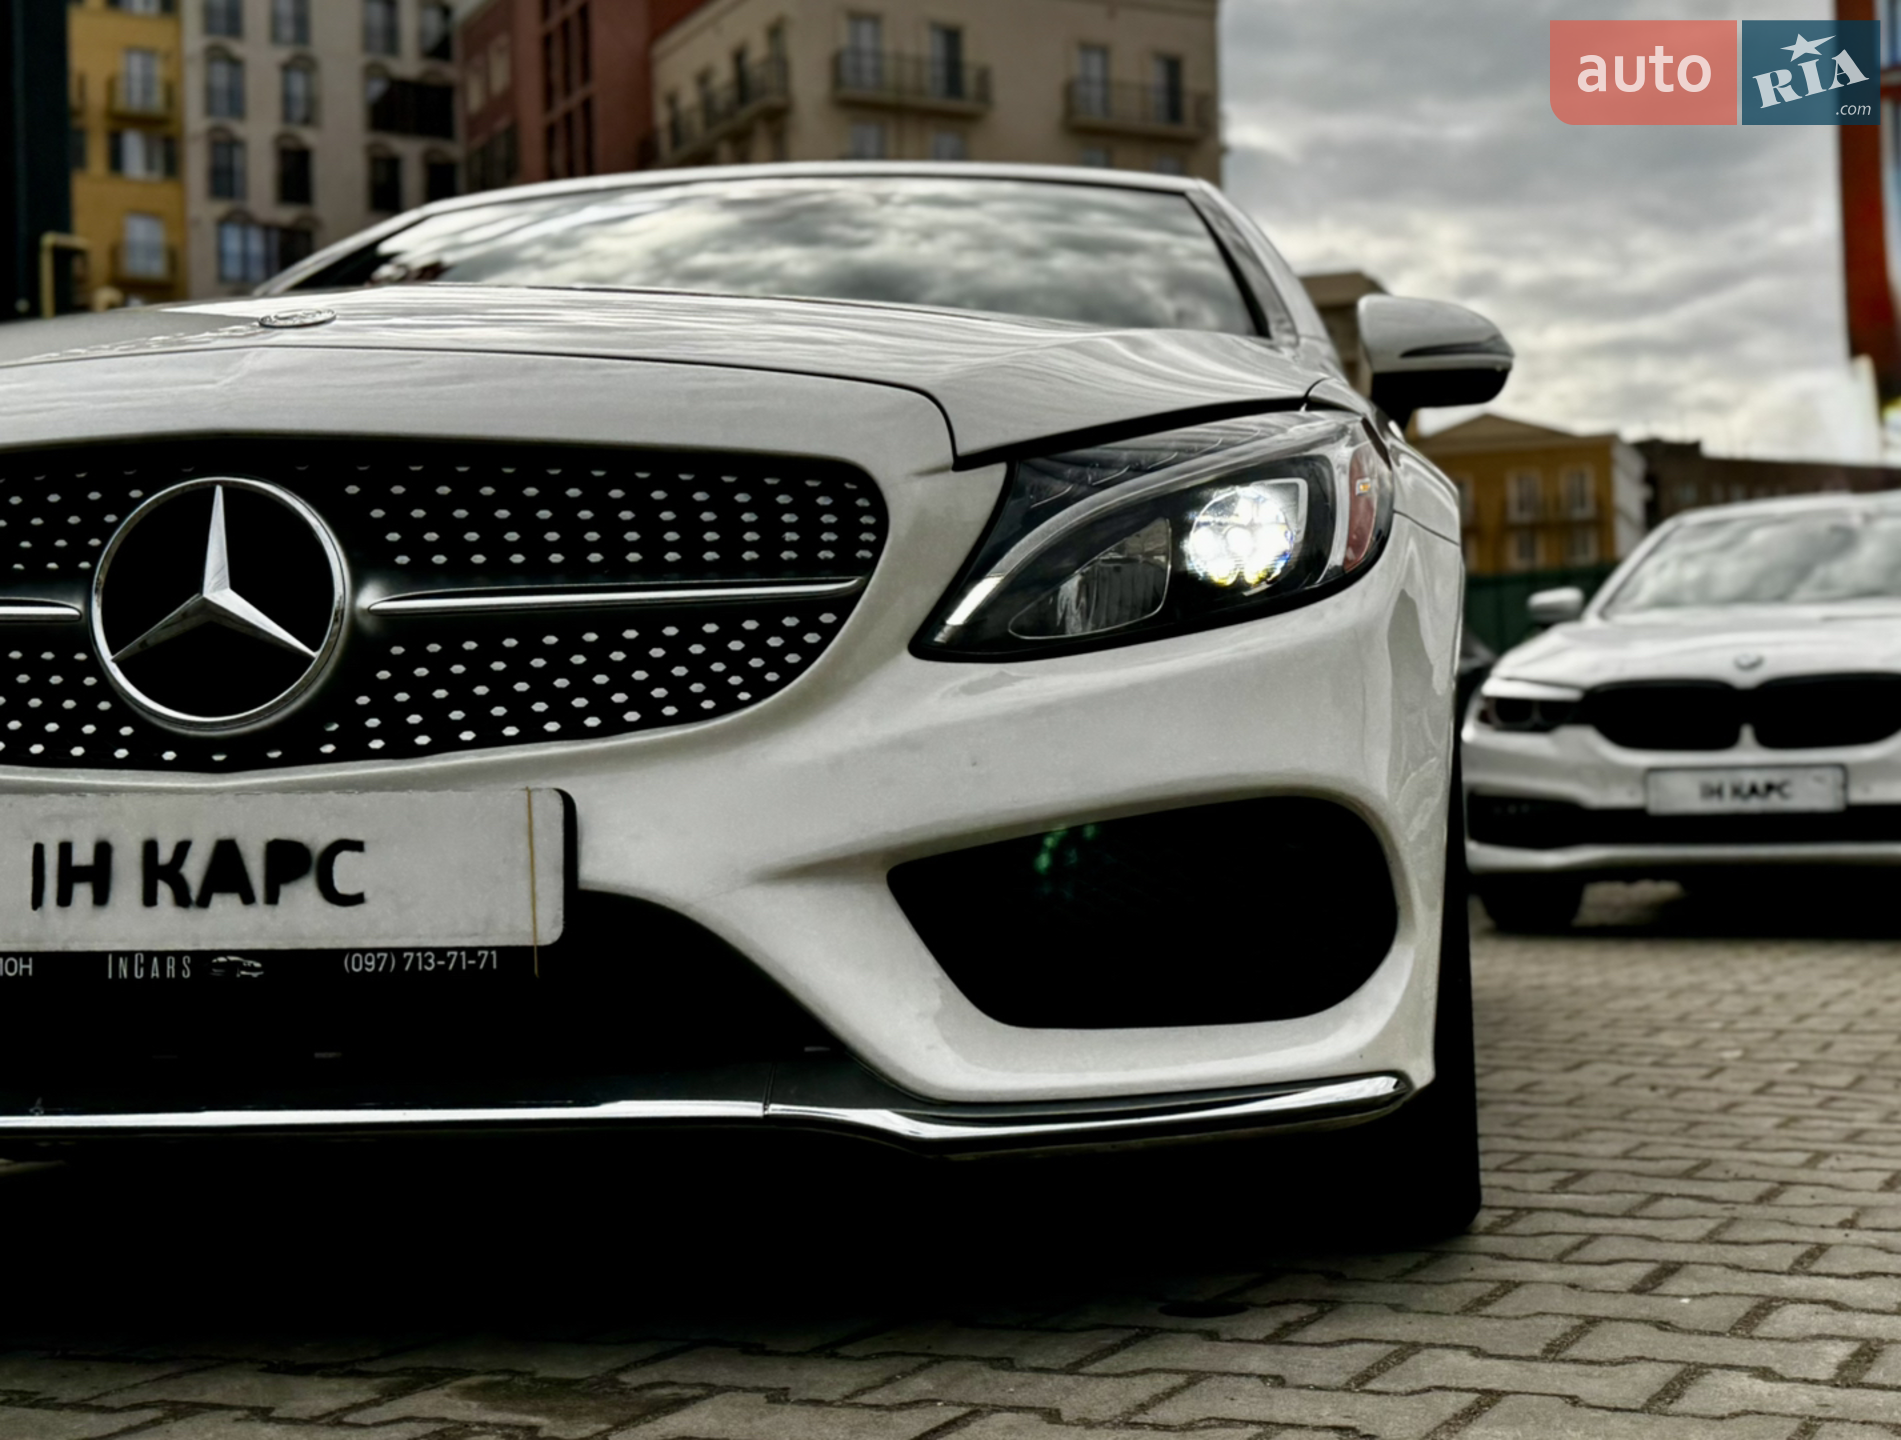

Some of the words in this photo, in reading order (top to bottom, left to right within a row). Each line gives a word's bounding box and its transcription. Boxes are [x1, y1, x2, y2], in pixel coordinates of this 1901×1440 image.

[31, 839, 114, 912] ІН
[141, 837, 366, 909] КАРС
[343, 951, 396, 974] (097)
[402, 950, 498, 972] 713-71-71
